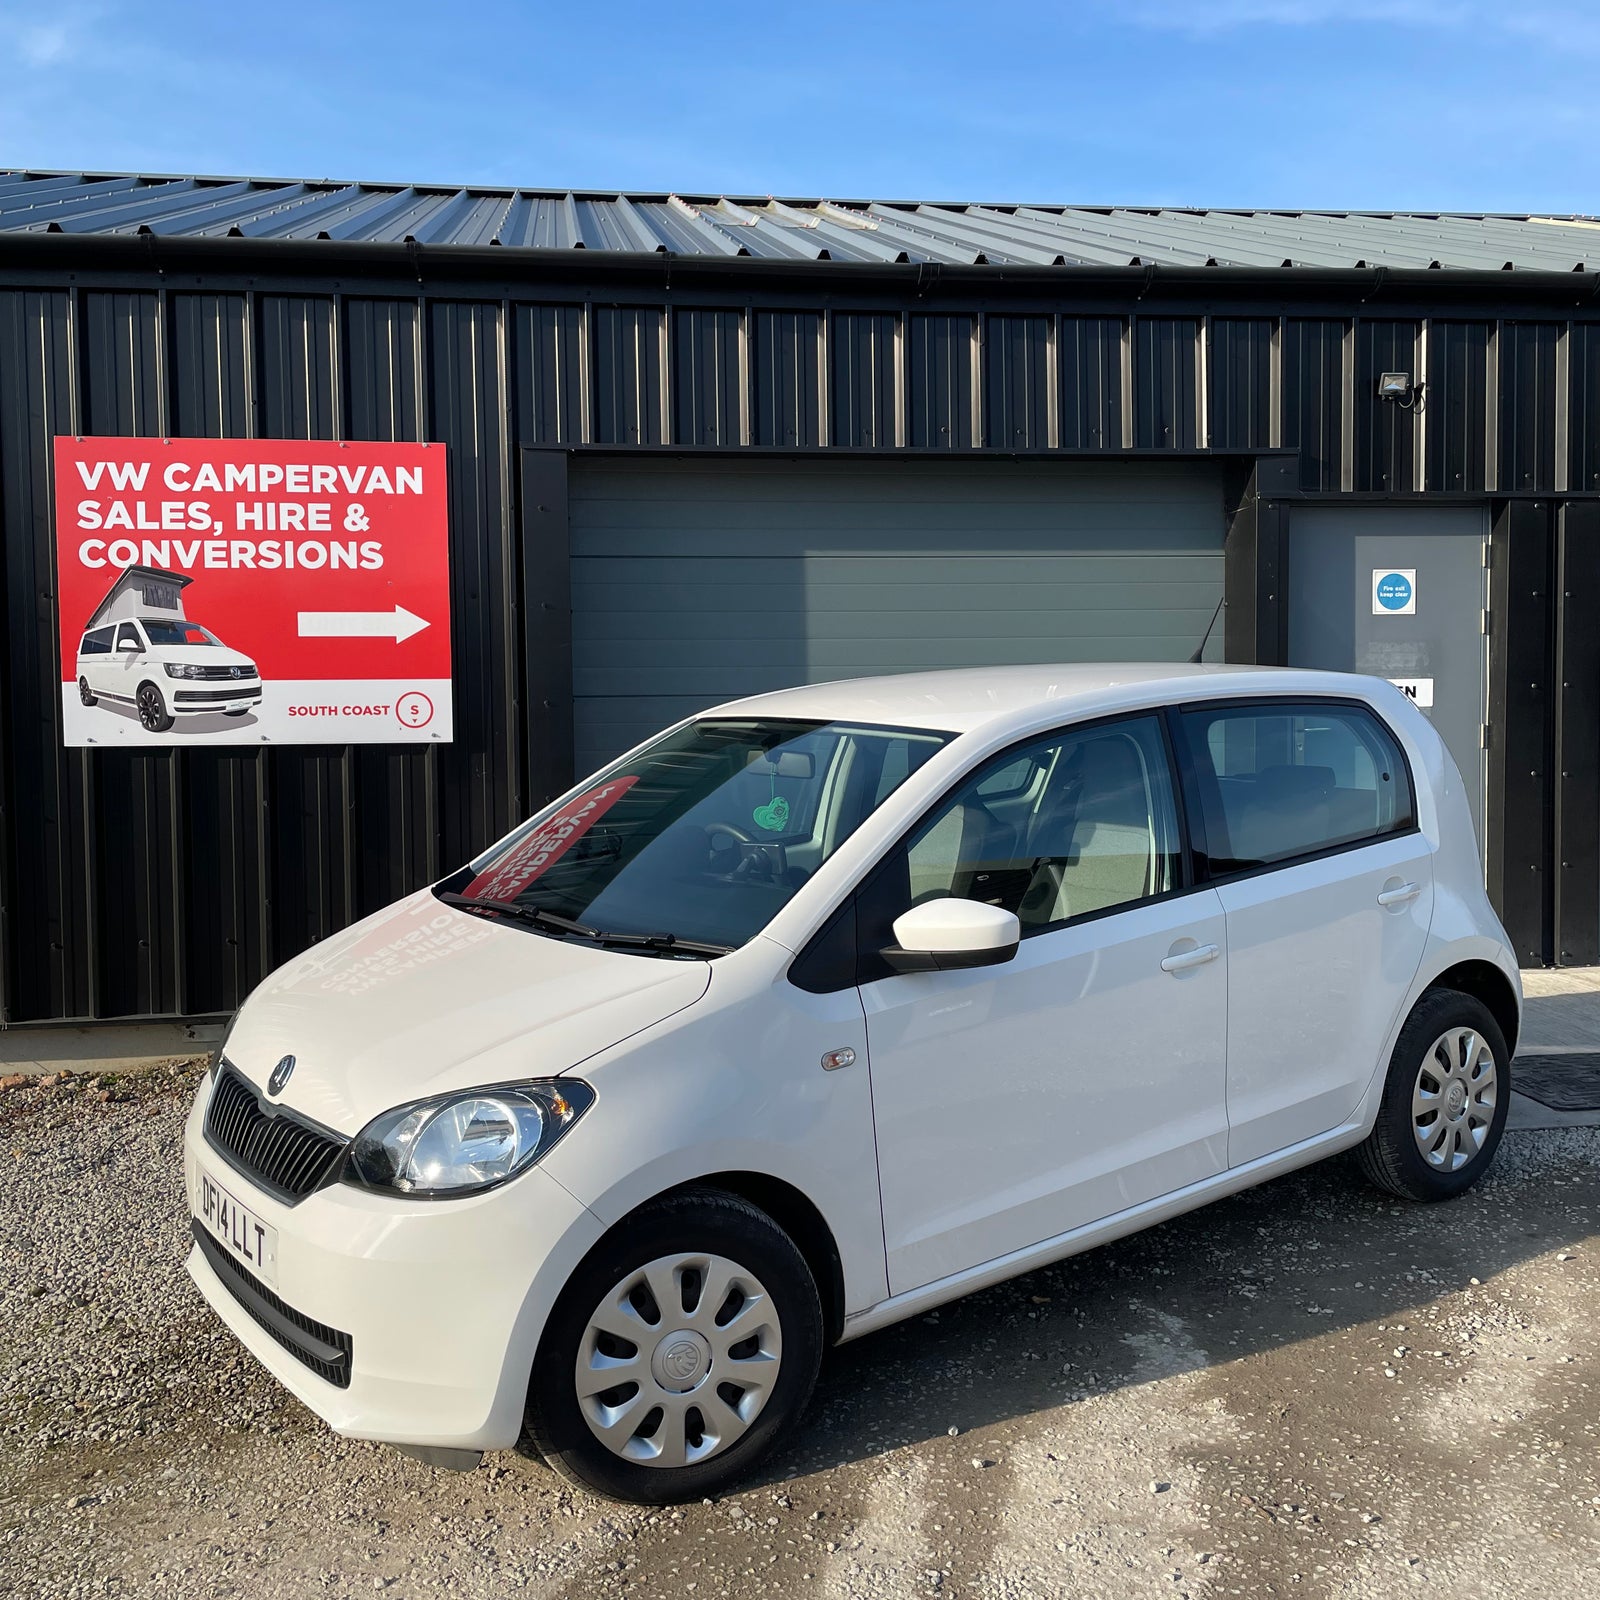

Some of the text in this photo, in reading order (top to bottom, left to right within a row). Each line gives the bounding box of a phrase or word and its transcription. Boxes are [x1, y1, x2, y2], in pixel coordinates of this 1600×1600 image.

[75, 461, 424, 495] VW CAMPERVAN
[76, 500, 370, 536] SALES, HIRE &
[78, 539, 384, 570] CONVERSIONS
[288, 706, 338, 716] SOUTH
[342, 706, 390, 716] COAST
[202, 1175, 265, 1268] DF14 LLT
